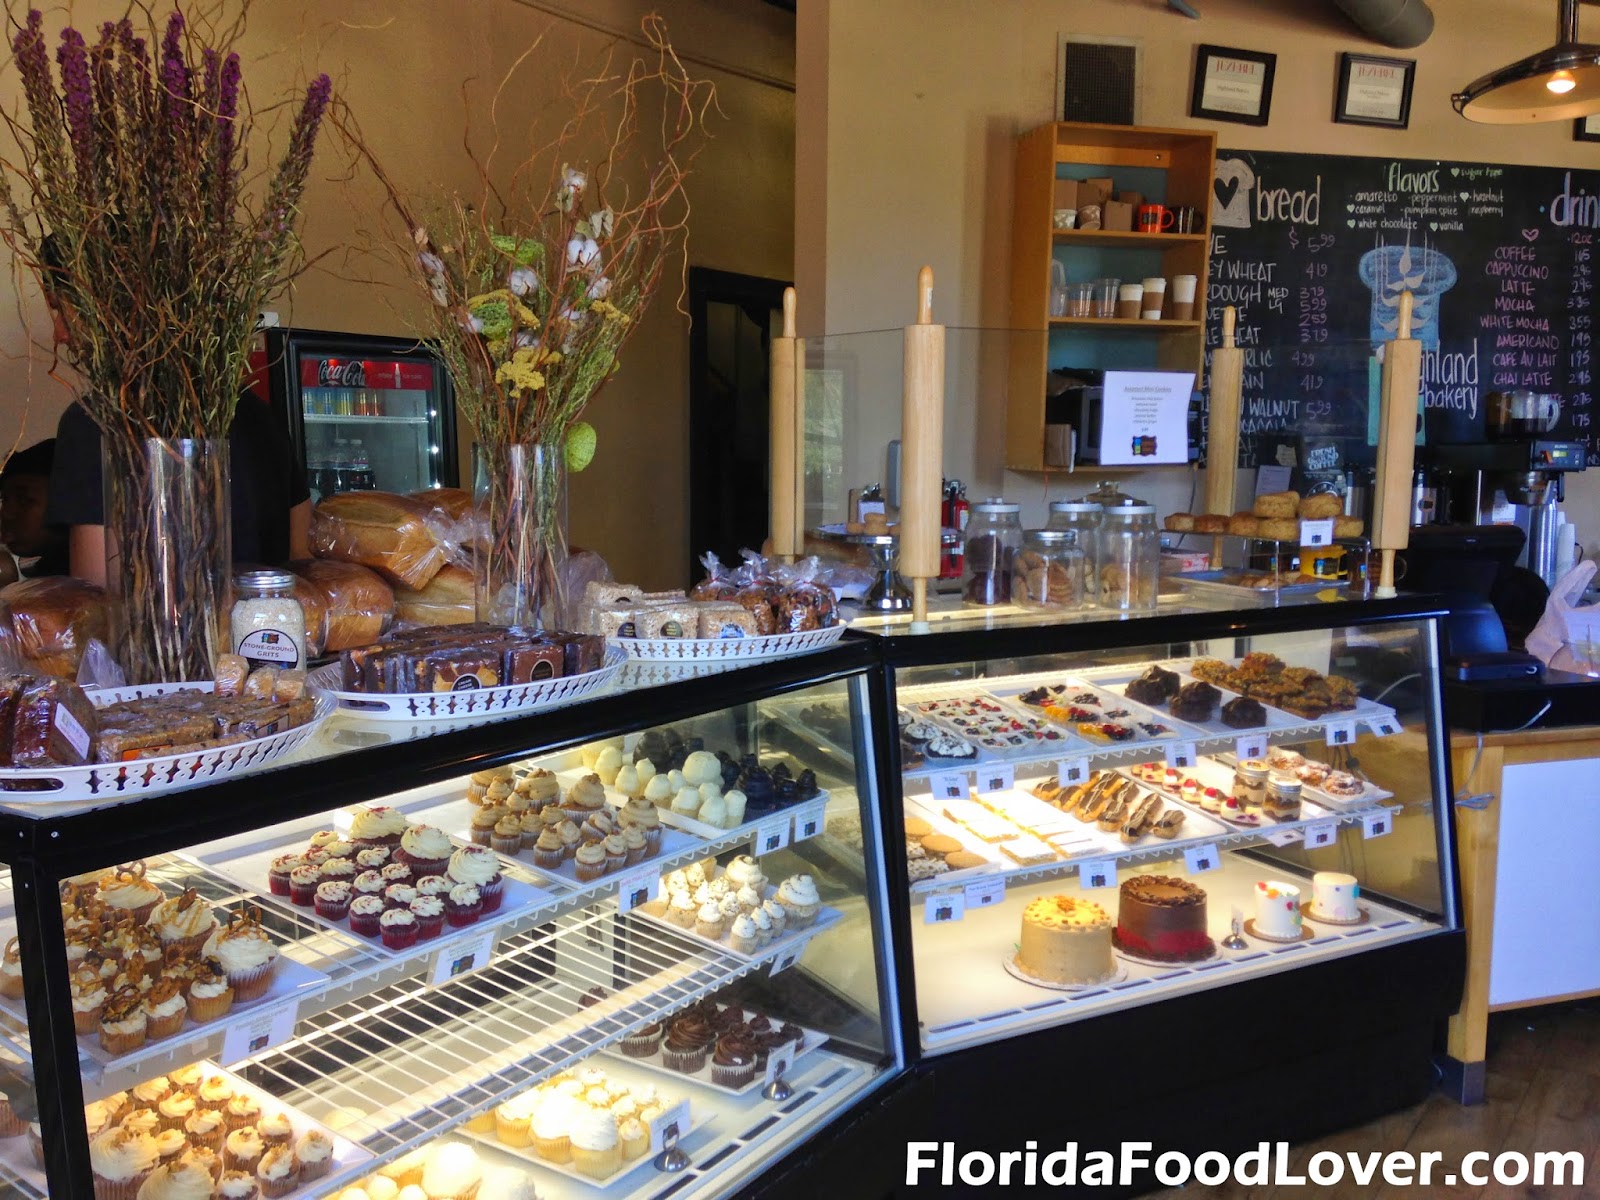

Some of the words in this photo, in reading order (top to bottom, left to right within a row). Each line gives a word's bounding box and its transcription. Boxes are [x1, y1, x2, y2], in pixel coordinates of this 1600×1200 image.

[1388, 162, 1440, 194] flavors
[1461, 168, 1484, 181] sugar
[1257, 174, 1321, 226] bread
[1354, 191, 1398, 203] amaretto
[1411, 193, 1458, 206] peppermint
[1549, 171, 1600, 229] drin
[1355, 203, 1386, 214] caramel
[1404, 203, 1437, 218] pumpkin
[1438, 205, 1459, 216] spice
[1470, 205, 1504, 217] raspberry
[1357, 218, 1377, 229] white
[1380, 217, 1418, 230] chocolate
[1439, 221, 1464, 232] vanilla
[1494, 246, 1537, 261] COFFEE
[1227, 260, 1277, 283] WHEAT
[1485, 261, 1549, 279] CAPPUCCINO
[1267, 287, 1289, 298] MED
[1501, 280, 1536, 296] LATTE
[1495, 296, 1536, 312] MOCHA
[1480, 315, 1514, 329] WHITE
[1515, 316, 1550, 333] MOCHA
[1496, 334, 1560, 350] AMERICANO
[1492, 353, 1517, 367] CAFE
[1520, 351, 1534, 367] AU
[1537, 354, 1557, 367] LAIT
[1493, 372, 1518, 386] CHAI
[1521, 372, 1553, 386] LATTE
[1249, 398, 1300, 419] WALNUT
[1424, 383, 1478, 420] bakery
[243, 642, 294, 652] STONE-GROUND
[256, 650, 280, 658] GRITS
